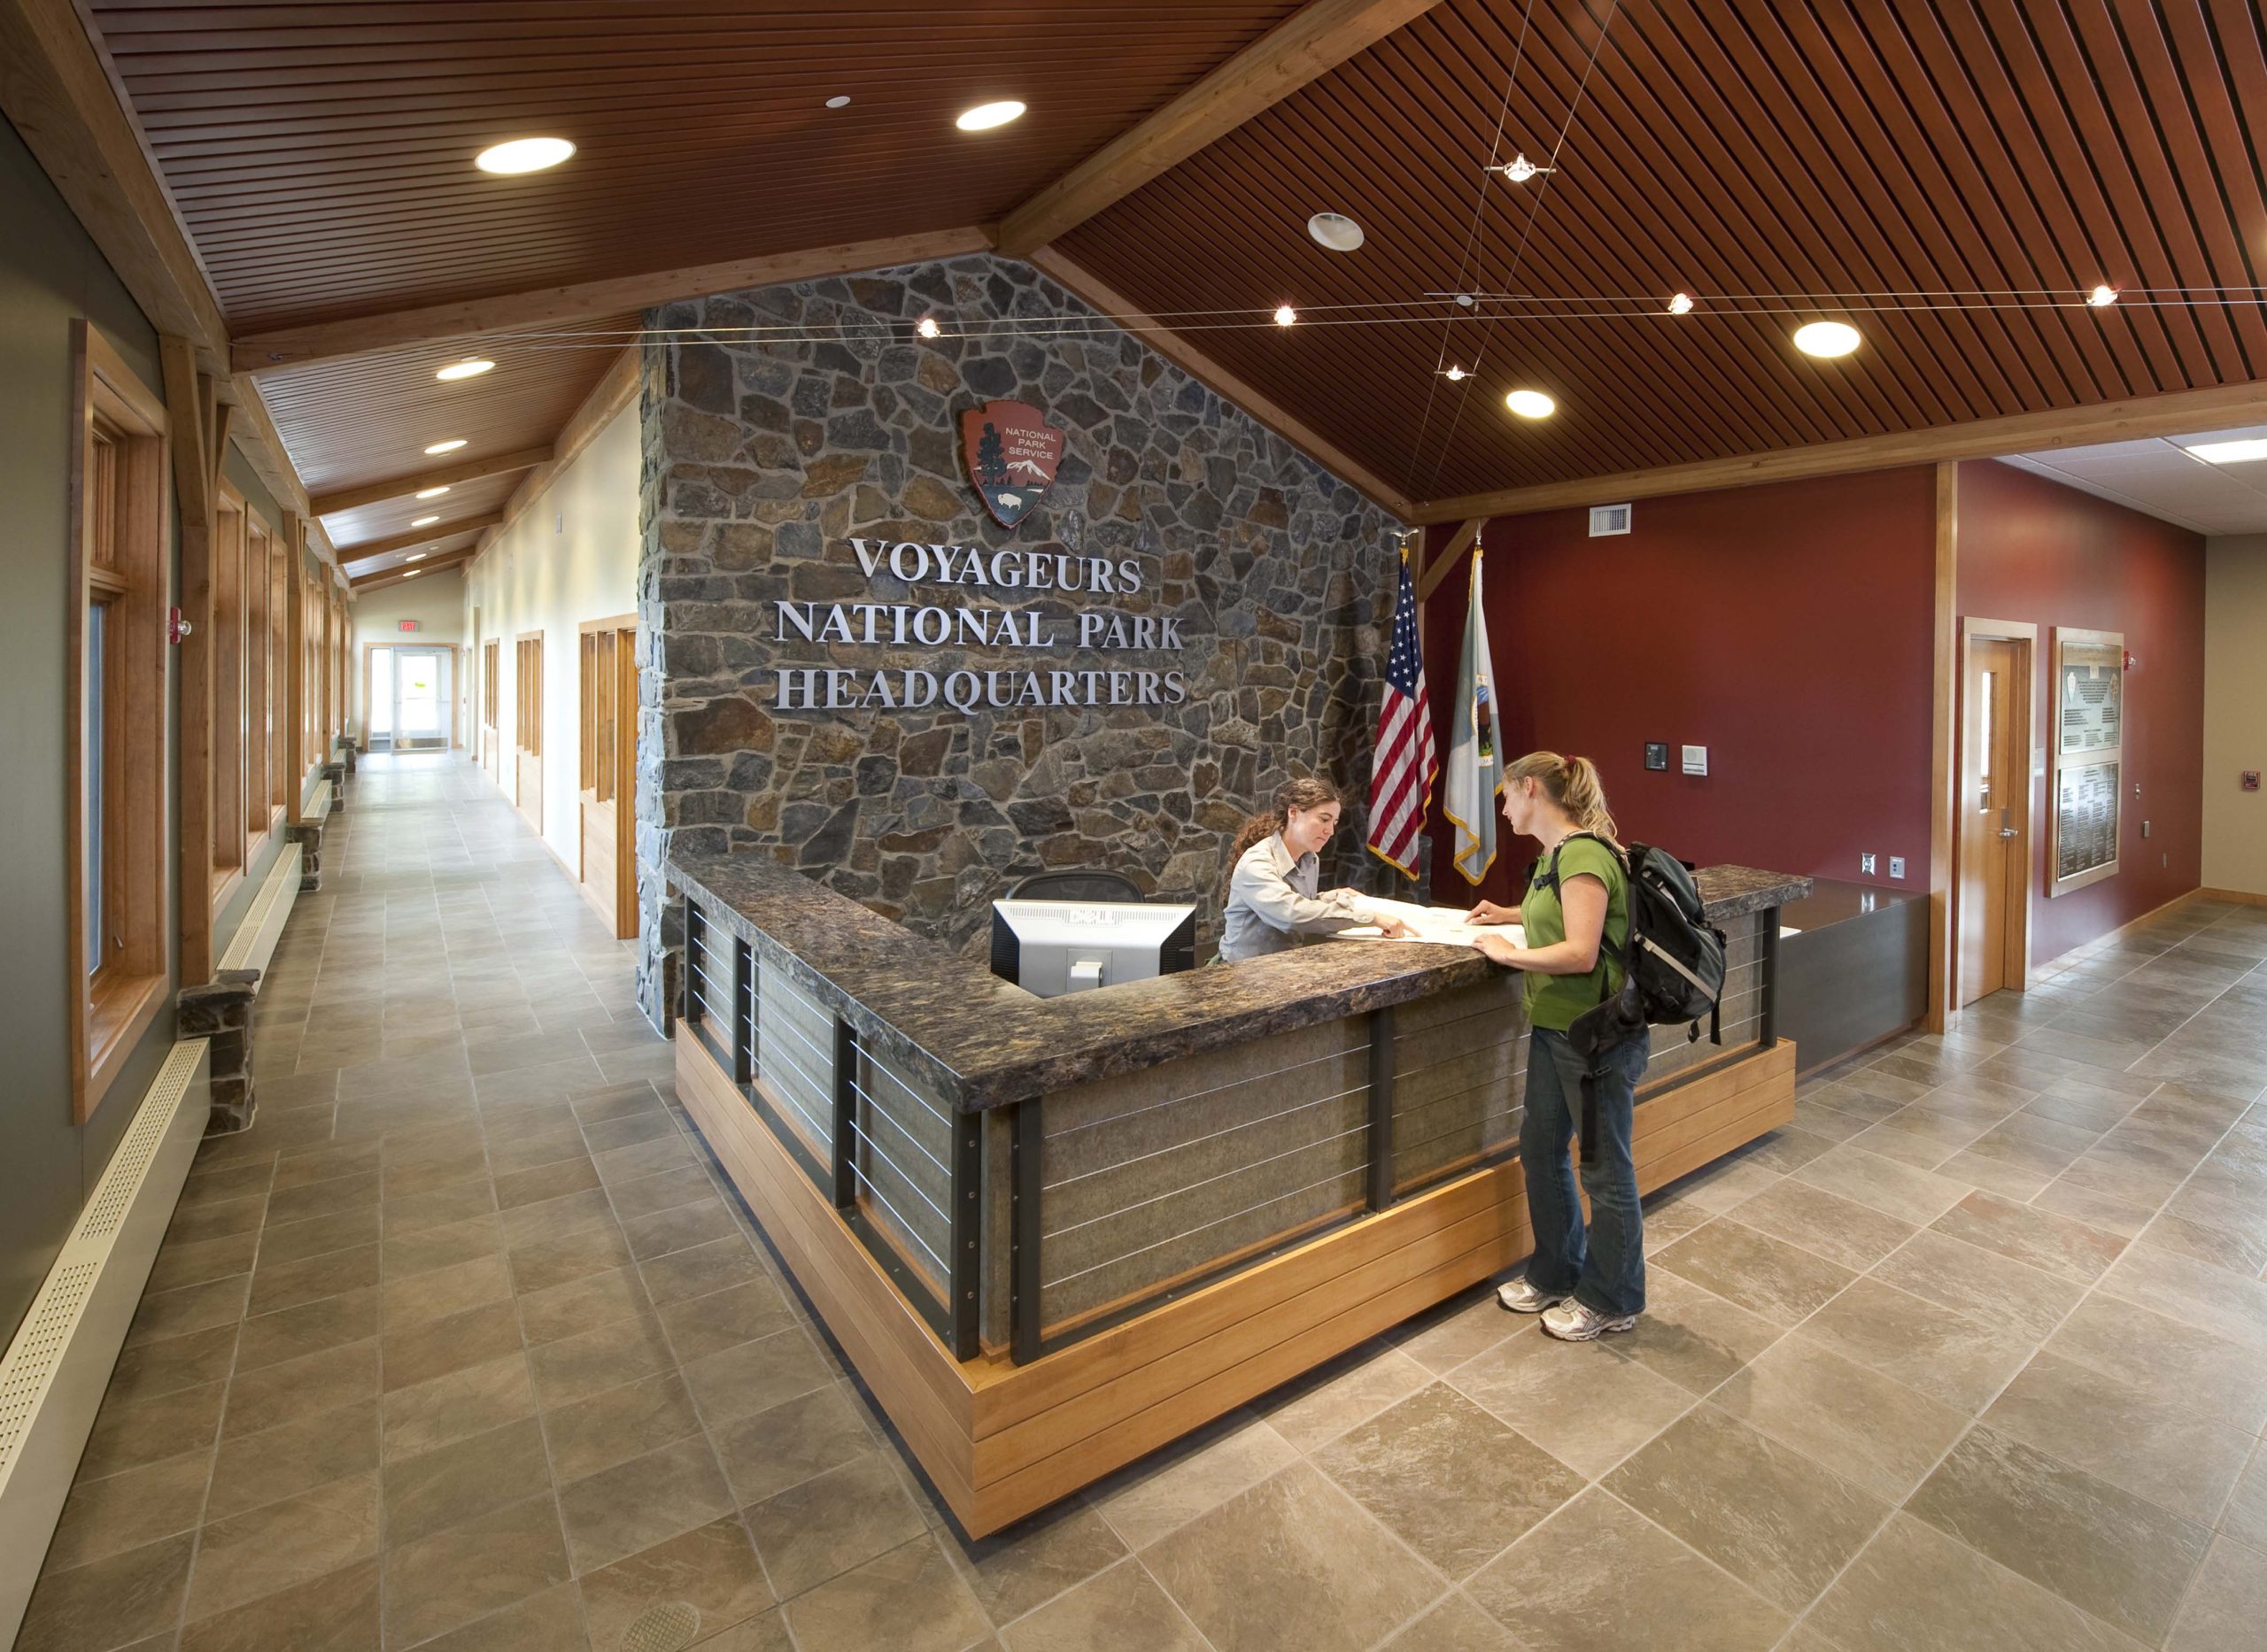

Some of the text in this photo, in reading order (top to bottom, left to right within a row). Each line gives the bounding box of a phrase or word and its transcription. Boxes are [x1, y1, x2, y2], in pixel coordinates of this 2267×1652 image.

[1005, 428, 1056, 442] NATIONAL
[1017, 438, 1046, 450] PARK
[1009, 447, 1054, 459] SERVICE
[849, 538, 1141, 594] VOYAGEURS
[773, 601, 1184, 650] NATIONAL PARK
[773, 668, 1187, 715] HEADQUARTERS
